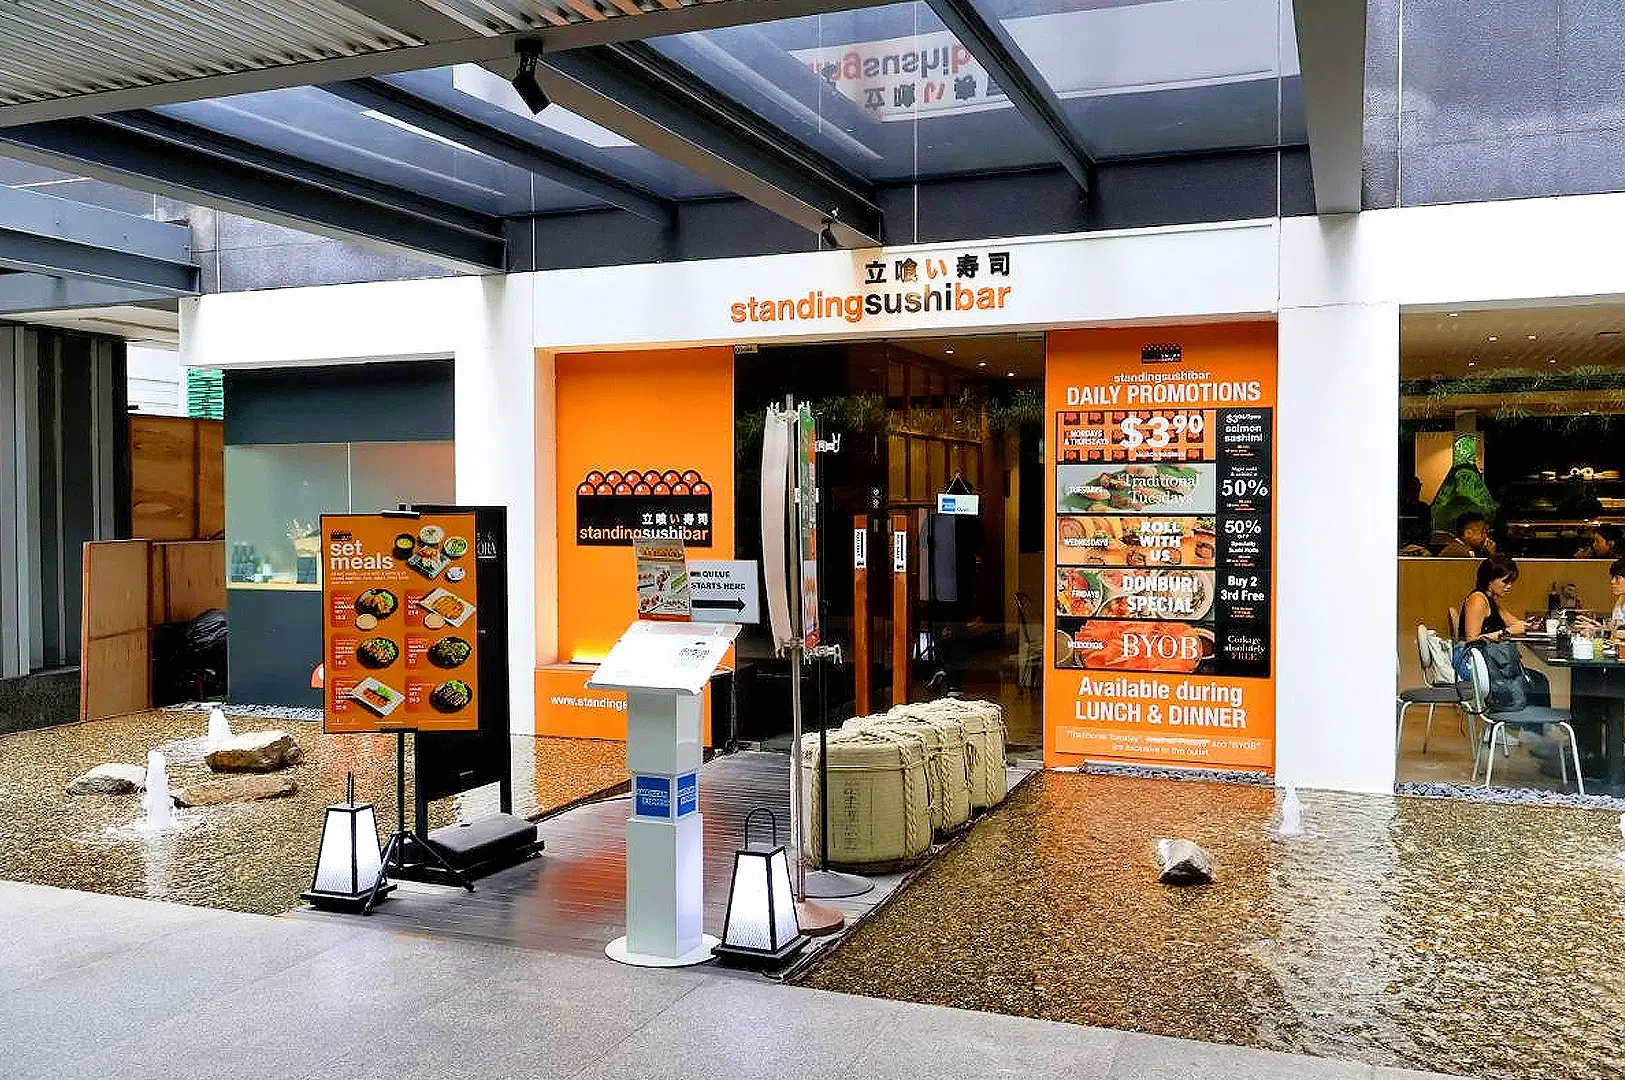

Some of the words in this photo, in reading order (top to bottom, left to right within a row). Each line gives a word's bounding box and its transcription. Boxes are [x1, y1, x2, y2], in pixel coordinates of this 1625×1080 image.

[864, 252, 1010, 285] 立喰い寿司
[730, 282, 1012, 323] standingsushibar
[1113, 371, 1211, 384] standingsushibar
[1067, 385, 1121, 406] DAILY
[1127, 381, 1262, 405] PROMOTIONS
[1070, 429, 1103, 438] MONDAYS
[1225, 423, 1261, 432] salmon
[1224, 433, 1262, 442] sashimi
[1121, 474, 1200, 487] Traditional
[1221, 479, 1269, 497] 50%
[1128, 491, 1196, 505] Tuesdays
[579, 525, 709, 541] standingsushibar
[1140, 521, 1181, 534] ROLL
[1224, 519, 1262, 533] 50%
[330, 539, 363, 556] set
[1063, 537, 1109, 547] WEDNESDAYS
[1139, 535, 1181, 548] WITH
[330, 552, 393, 570] meals
[1151, 549, 1170, 562] US
[690, 582, 722, 590] STARTS
[1122, 575, 1198, 592] DONBURI
[1228, 575, 1248, 588] Buy
[1250, 576, 1258, 587] 2
[1072, 589, 1100, 599] FRIDAYS
[1220, 589, 1239, 601] 3rd
[1241, 589, 1265, 601] Free
[1126, 595, 1194, 613] SPECIAL
[1122, 633, 1199, 660] BYOB
[1079, 676, 1170, 700] Available
[1176, 681, 1243, 707] during
[1075, 701, 1141, 723] LUNCH
[1147, 704, 1162, 724] &
[1168, 705, 1247, 729] DINNER
